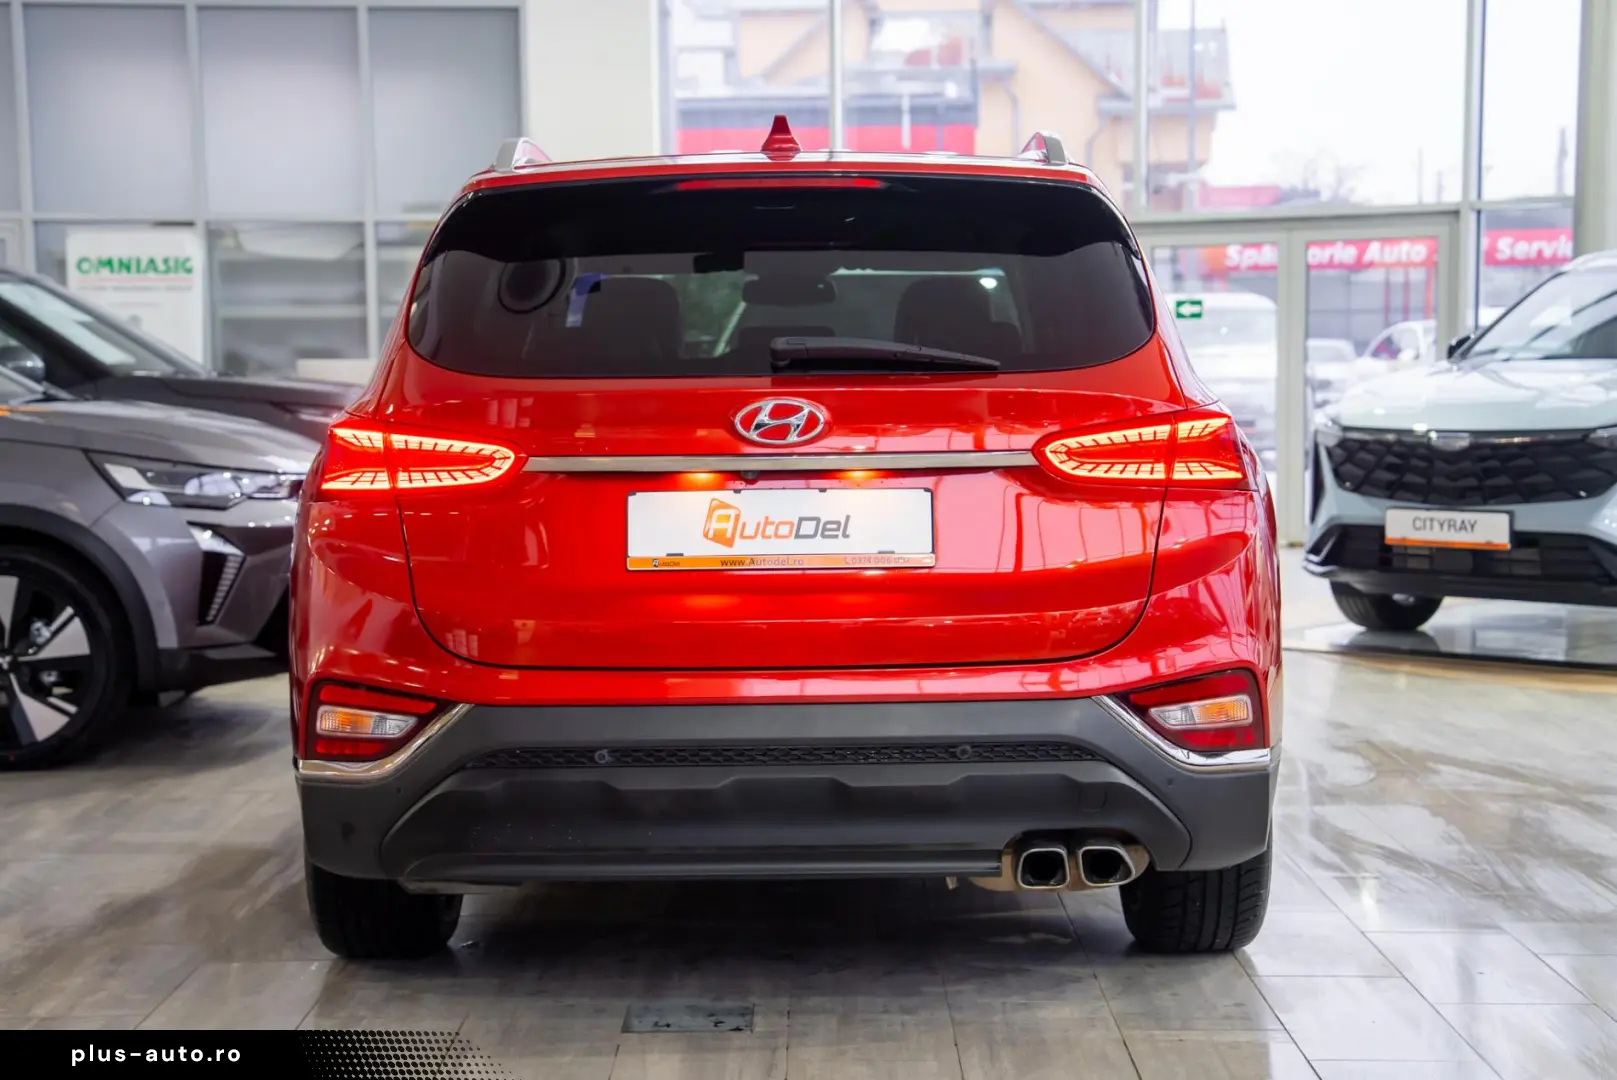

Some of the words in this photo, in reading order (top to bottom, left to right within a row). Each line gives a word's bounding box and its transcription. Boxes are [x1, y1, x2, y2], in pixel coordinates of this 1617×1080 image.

[1363, 241, 1428, 264] Auto
[77, 256, 194, 274] OMNIASIG
[704, 502, 850, 540] AutoDel
[1412, 516, 1478, 533] CITYRAY
